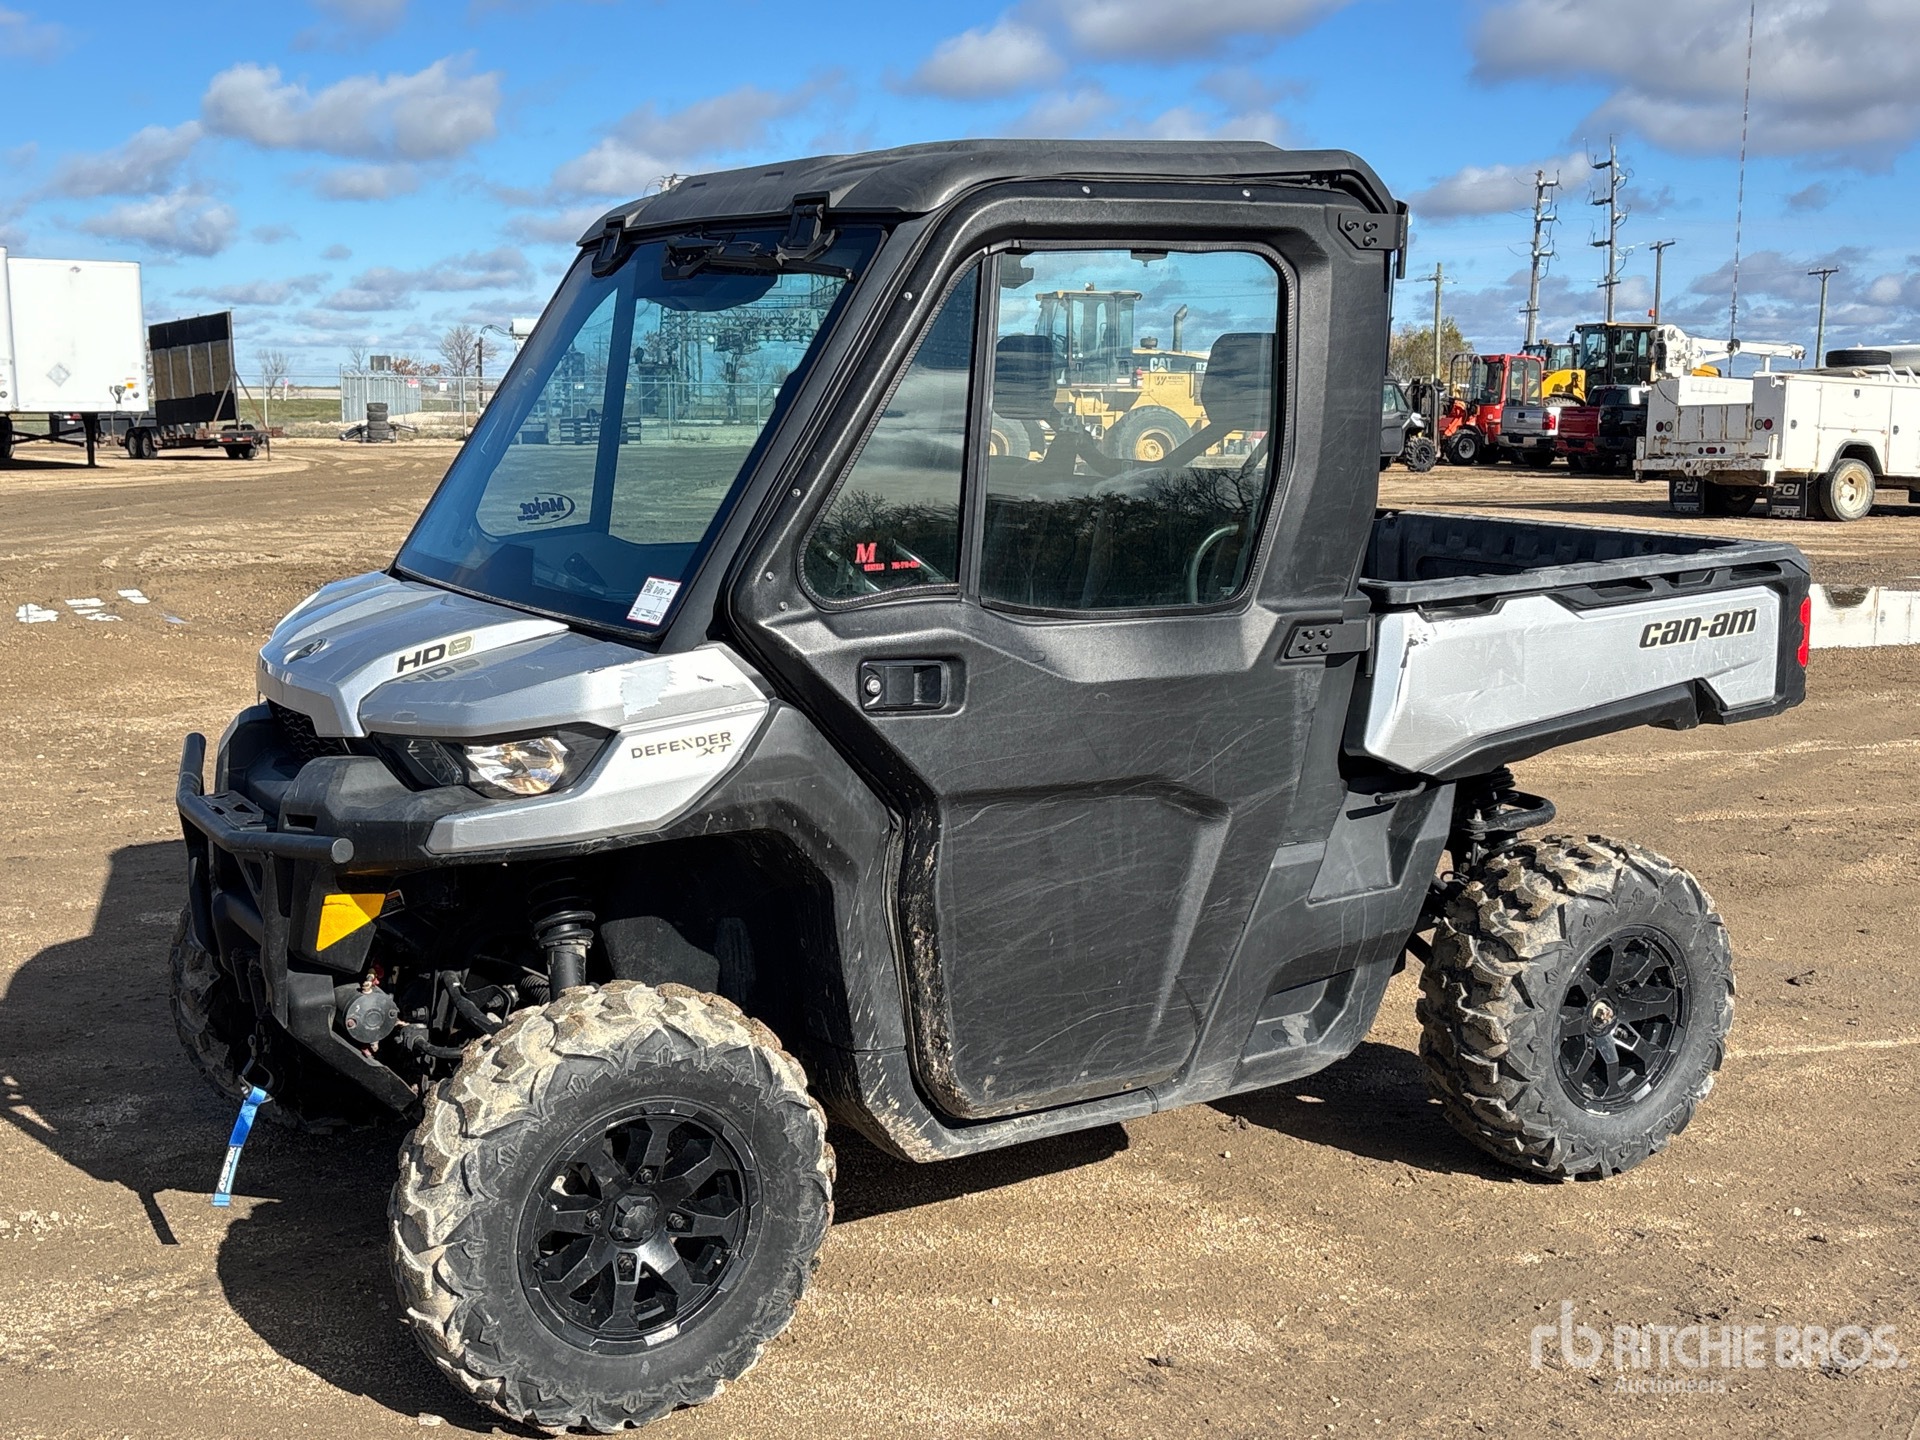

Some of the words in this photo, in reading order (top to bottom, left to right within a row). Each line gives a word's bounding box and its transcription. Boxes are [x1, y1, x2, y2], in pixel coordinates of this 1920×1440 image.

[1149, 357, 1173, 373] CAT
[1674, 481, 1698, 493] FGI
[1772, 483, 1800, 496] FGI
[854, 542, 877, 564] M
[1639, 608, 1757, 648] can-am
[397, 636, 472, 673] HD8
[631, 731, 732, 759] DEFENDER
[696, 743, 732, 759] XT
